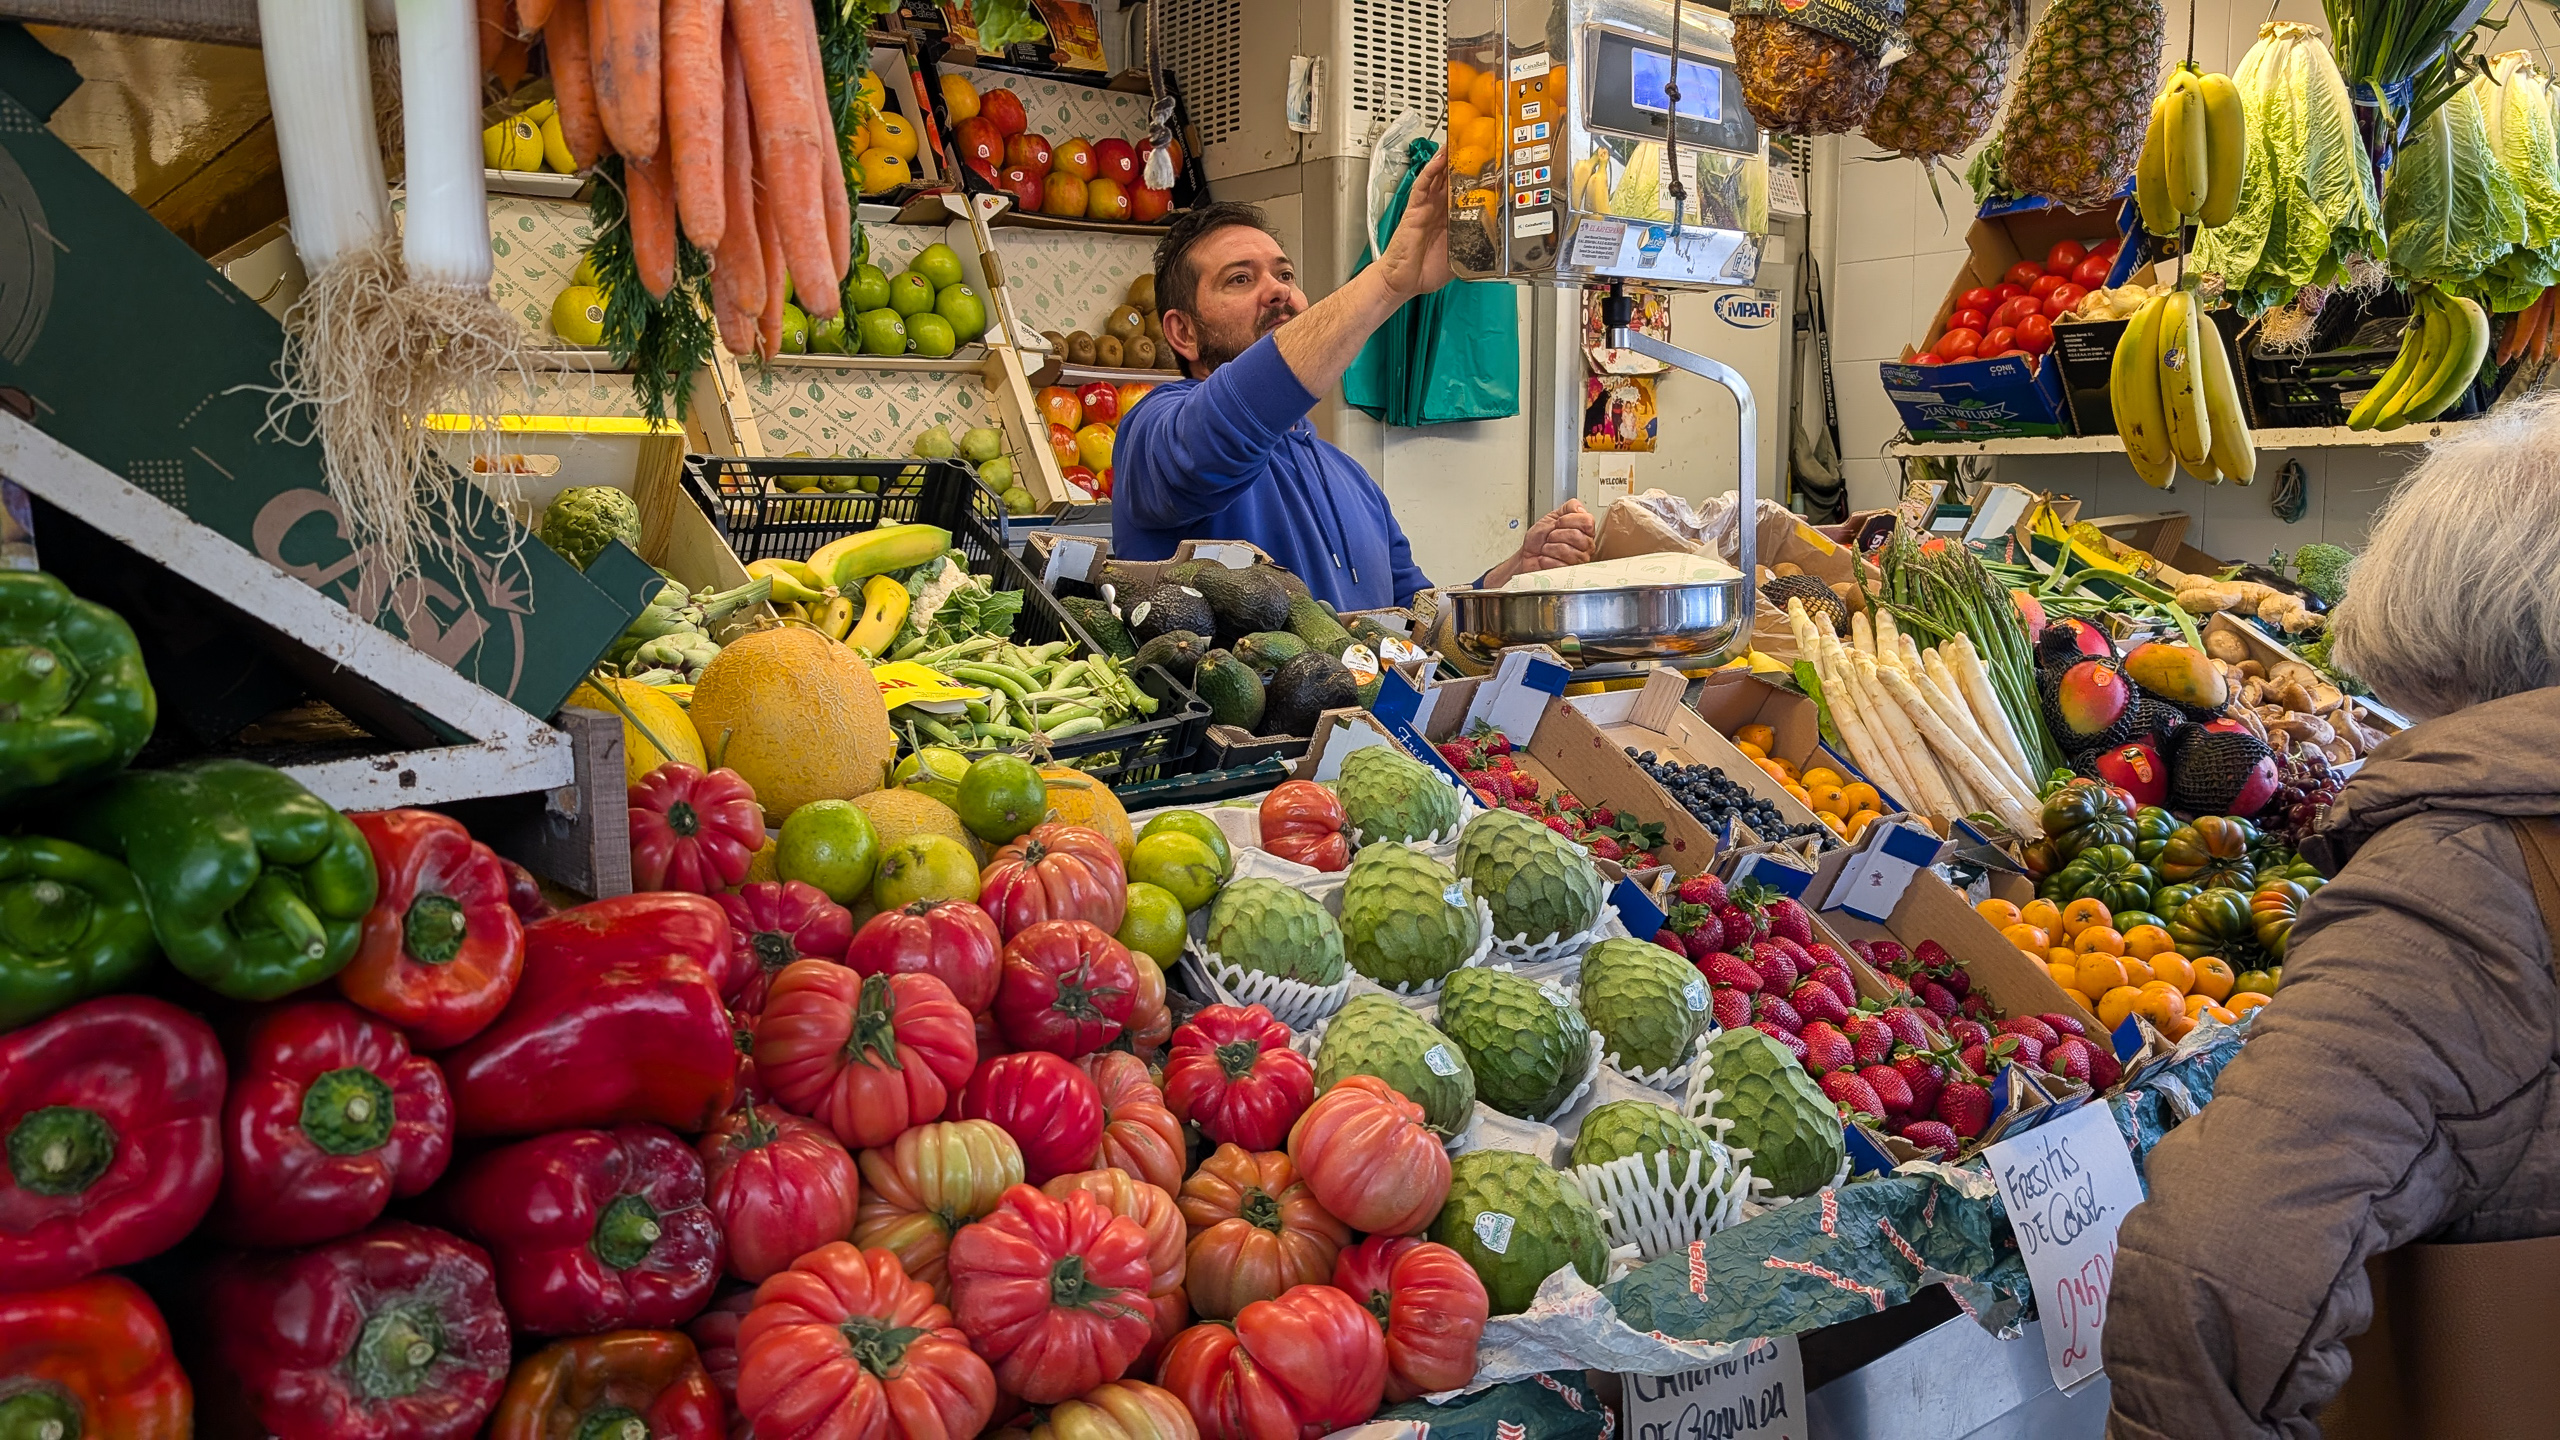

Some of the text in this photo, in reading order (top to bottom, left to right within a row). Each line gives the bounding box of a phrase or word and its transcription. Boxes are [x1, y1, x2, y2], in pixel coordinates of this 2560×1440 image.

[911, 8, 938, 19] Dates
[1817, 4, 1853, 24] PINEAPPLE
[1522, 60, 1548, 71] CaixaBank
[1525, 107, 1538, 115] VISA
[550, 223, 561, 234] con
[506, 229, 519, 241] Este
[517, 239, 534, 253] papel
[532, 251, 541, 259] no
[539, 257, 554, 269] tiene
[874, 238, 889, 251] 100%
[511, 280, 520, 288] en
[518, 287, 535, 301] papel
[534, 298, 549, 311] dura
[1989, 364, 2016, 373] CONIL
[822, 376, 847, 400] reciclado
[939, 400, 947, 408] La
[812, 404, 825, 415] Este
[823, 412, 838, 425] papel
[837, 421, 846, 429] no
[1927, 406, 2002, 420] LAS VIRTUDES
[781, 419, 790, 427] no
[788, 424, 815, 443] contamina
[1600, 477, 1628, 486] WELCOME
[2018, 1211, 2049, 1255] DE
